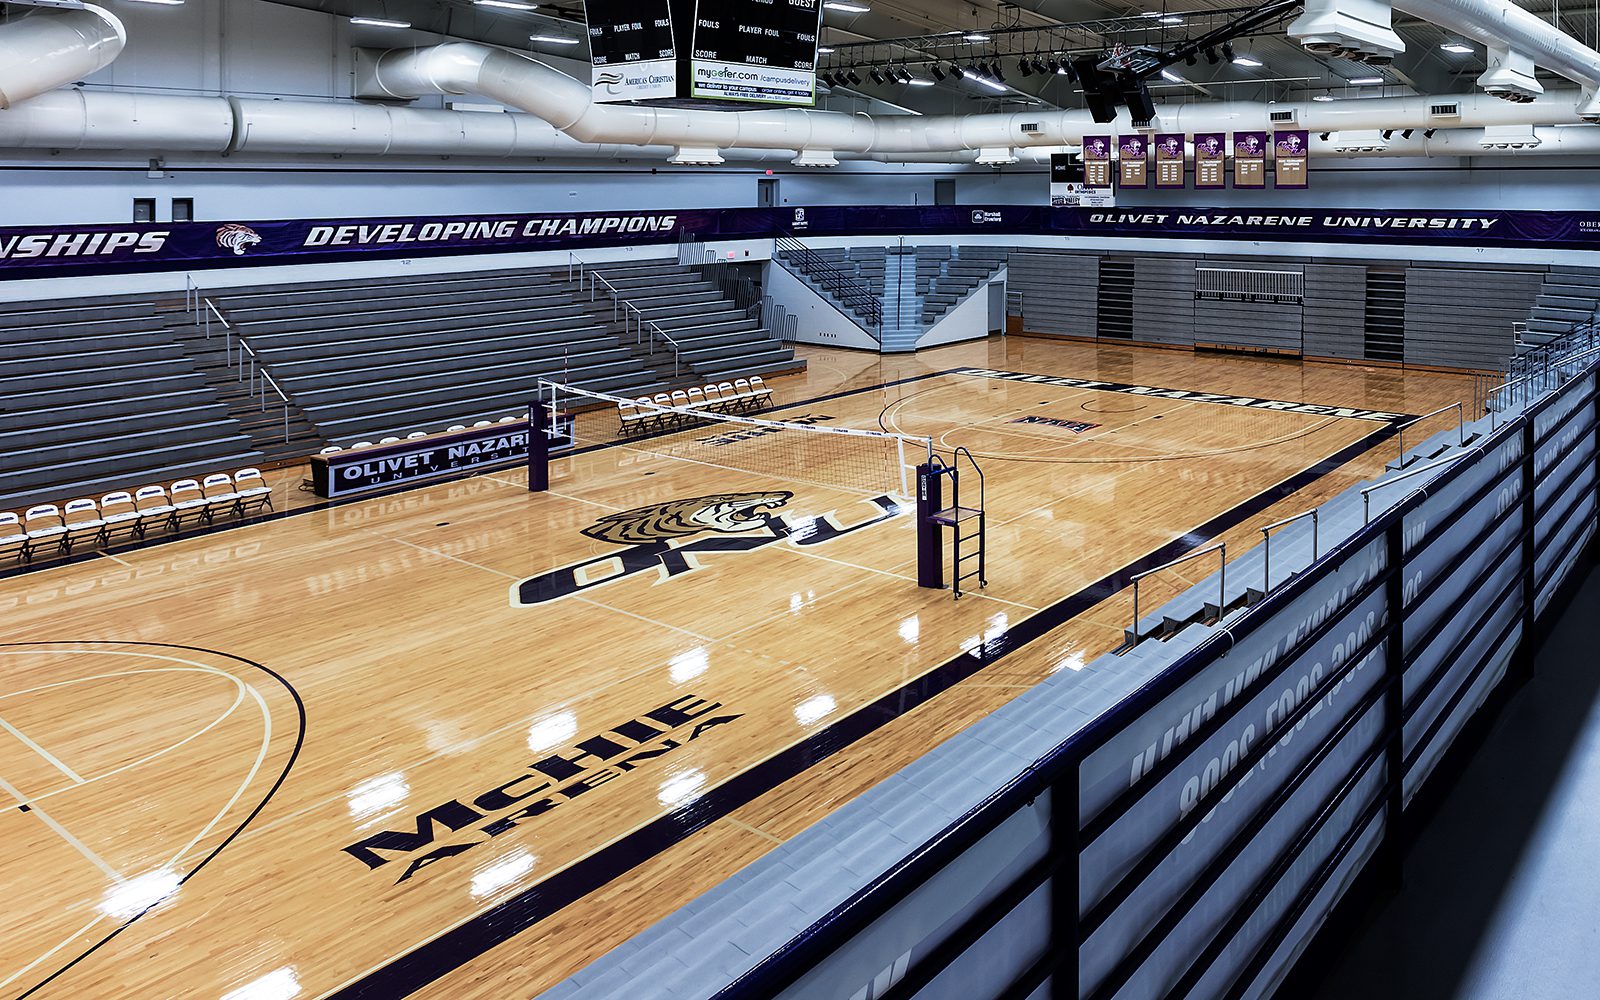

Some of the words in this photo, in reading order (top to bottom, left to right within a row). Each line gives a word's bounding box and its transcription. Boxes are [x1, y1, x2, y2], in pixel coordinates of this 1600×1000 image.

[613, 24, 631, 33] PLAYER
[631, 22, 643, 31] FOUL
[654, 19, 670, 27] FOULS
[698, 19, 720, 29] FOULS
[589, 27, 603, 36] FOULS
[738, 25, 762, 35] PLAYER
[764, 28, 780, 37] FOUL
[797, 33, 815, 42] FOULS
[624, 52, 640, 61] MATCH
[658, 49, 674, 58] SCORE
[695, 50, 717, 59] SCORE
[593, 56, 607, 64] SCORE
[745, 55, 768, 65] MATCH
[794, 60, 813, 69] SCORE
[648, 73, 674, 84] CHRISTIAN
[697, 67, 759, 81] mygofer.com
[760, 74, 811, 87] /campusdelivery
[1089, 213, 1169, 224] OLIVET
[1176, 214, 1313, 226] NAZARENE
[1322, 216, 1499, 229] UNIVERSITY
[302, 220, 518, 247] DEVELOPING
[521, 215, 678, 237] CHAMPIONS
[962, 369, 1103, 388] OLIVET
[1116, 386, 1403, 421] NAZARENE
[343, 451, 435, 480] OLIVET
[447, 426, 566, 459] NAZARE
[370, 447, 530, 484] UNIVERSIT
[393, 713, 746, 886] ARENA
